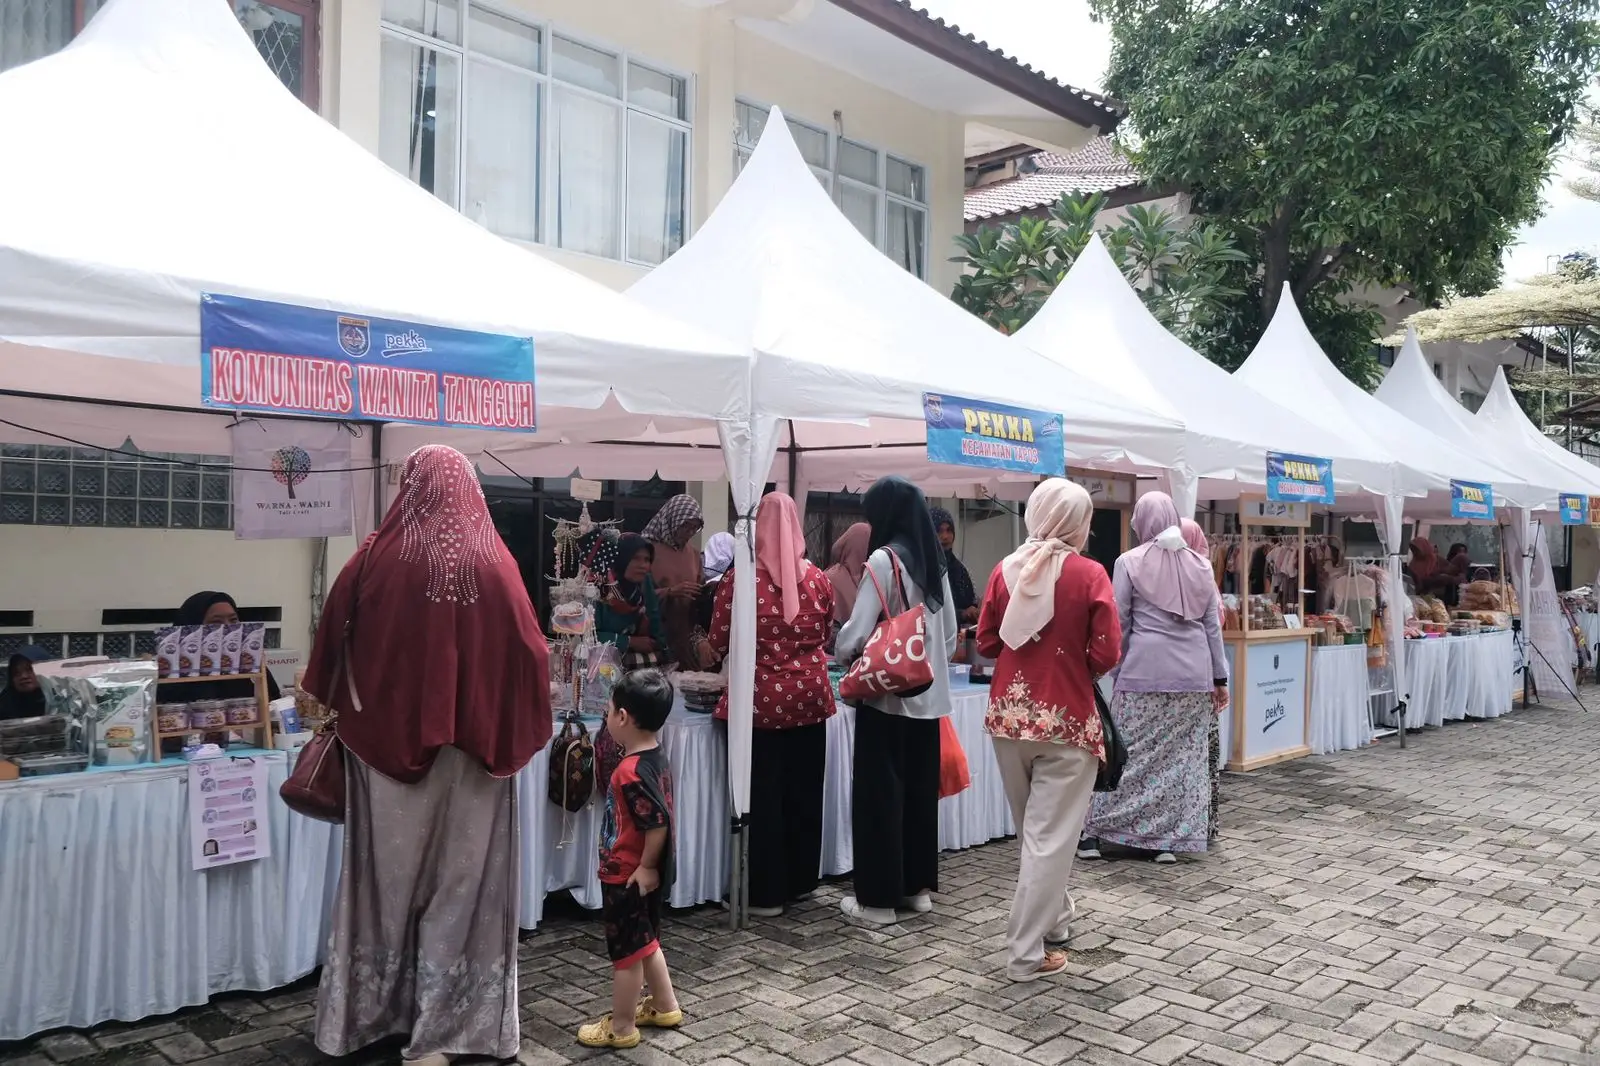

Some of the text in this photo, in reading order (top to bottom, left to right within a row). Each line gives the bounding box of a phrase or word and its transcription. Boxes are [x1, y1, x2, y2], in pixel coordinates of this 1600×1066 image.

[385, 330, 426, 349] pekka
[212, 348, 534, 428] KOMUNITAS WANITA TANGGUH
[962, 408, 1034, 443] PEKKA
[962, 438, 1039, 464] KECAMATAN TAPOS
[1284, 460, 1320, 482] PEKKA
[256, 502, 292, 511] WARNA
[299, 500, 332, 509] WARNI
[267, 657, 299, 666] SHARP
[859, 669, 900, 692] TE
[1265, 698, 1285, 722] pekka
